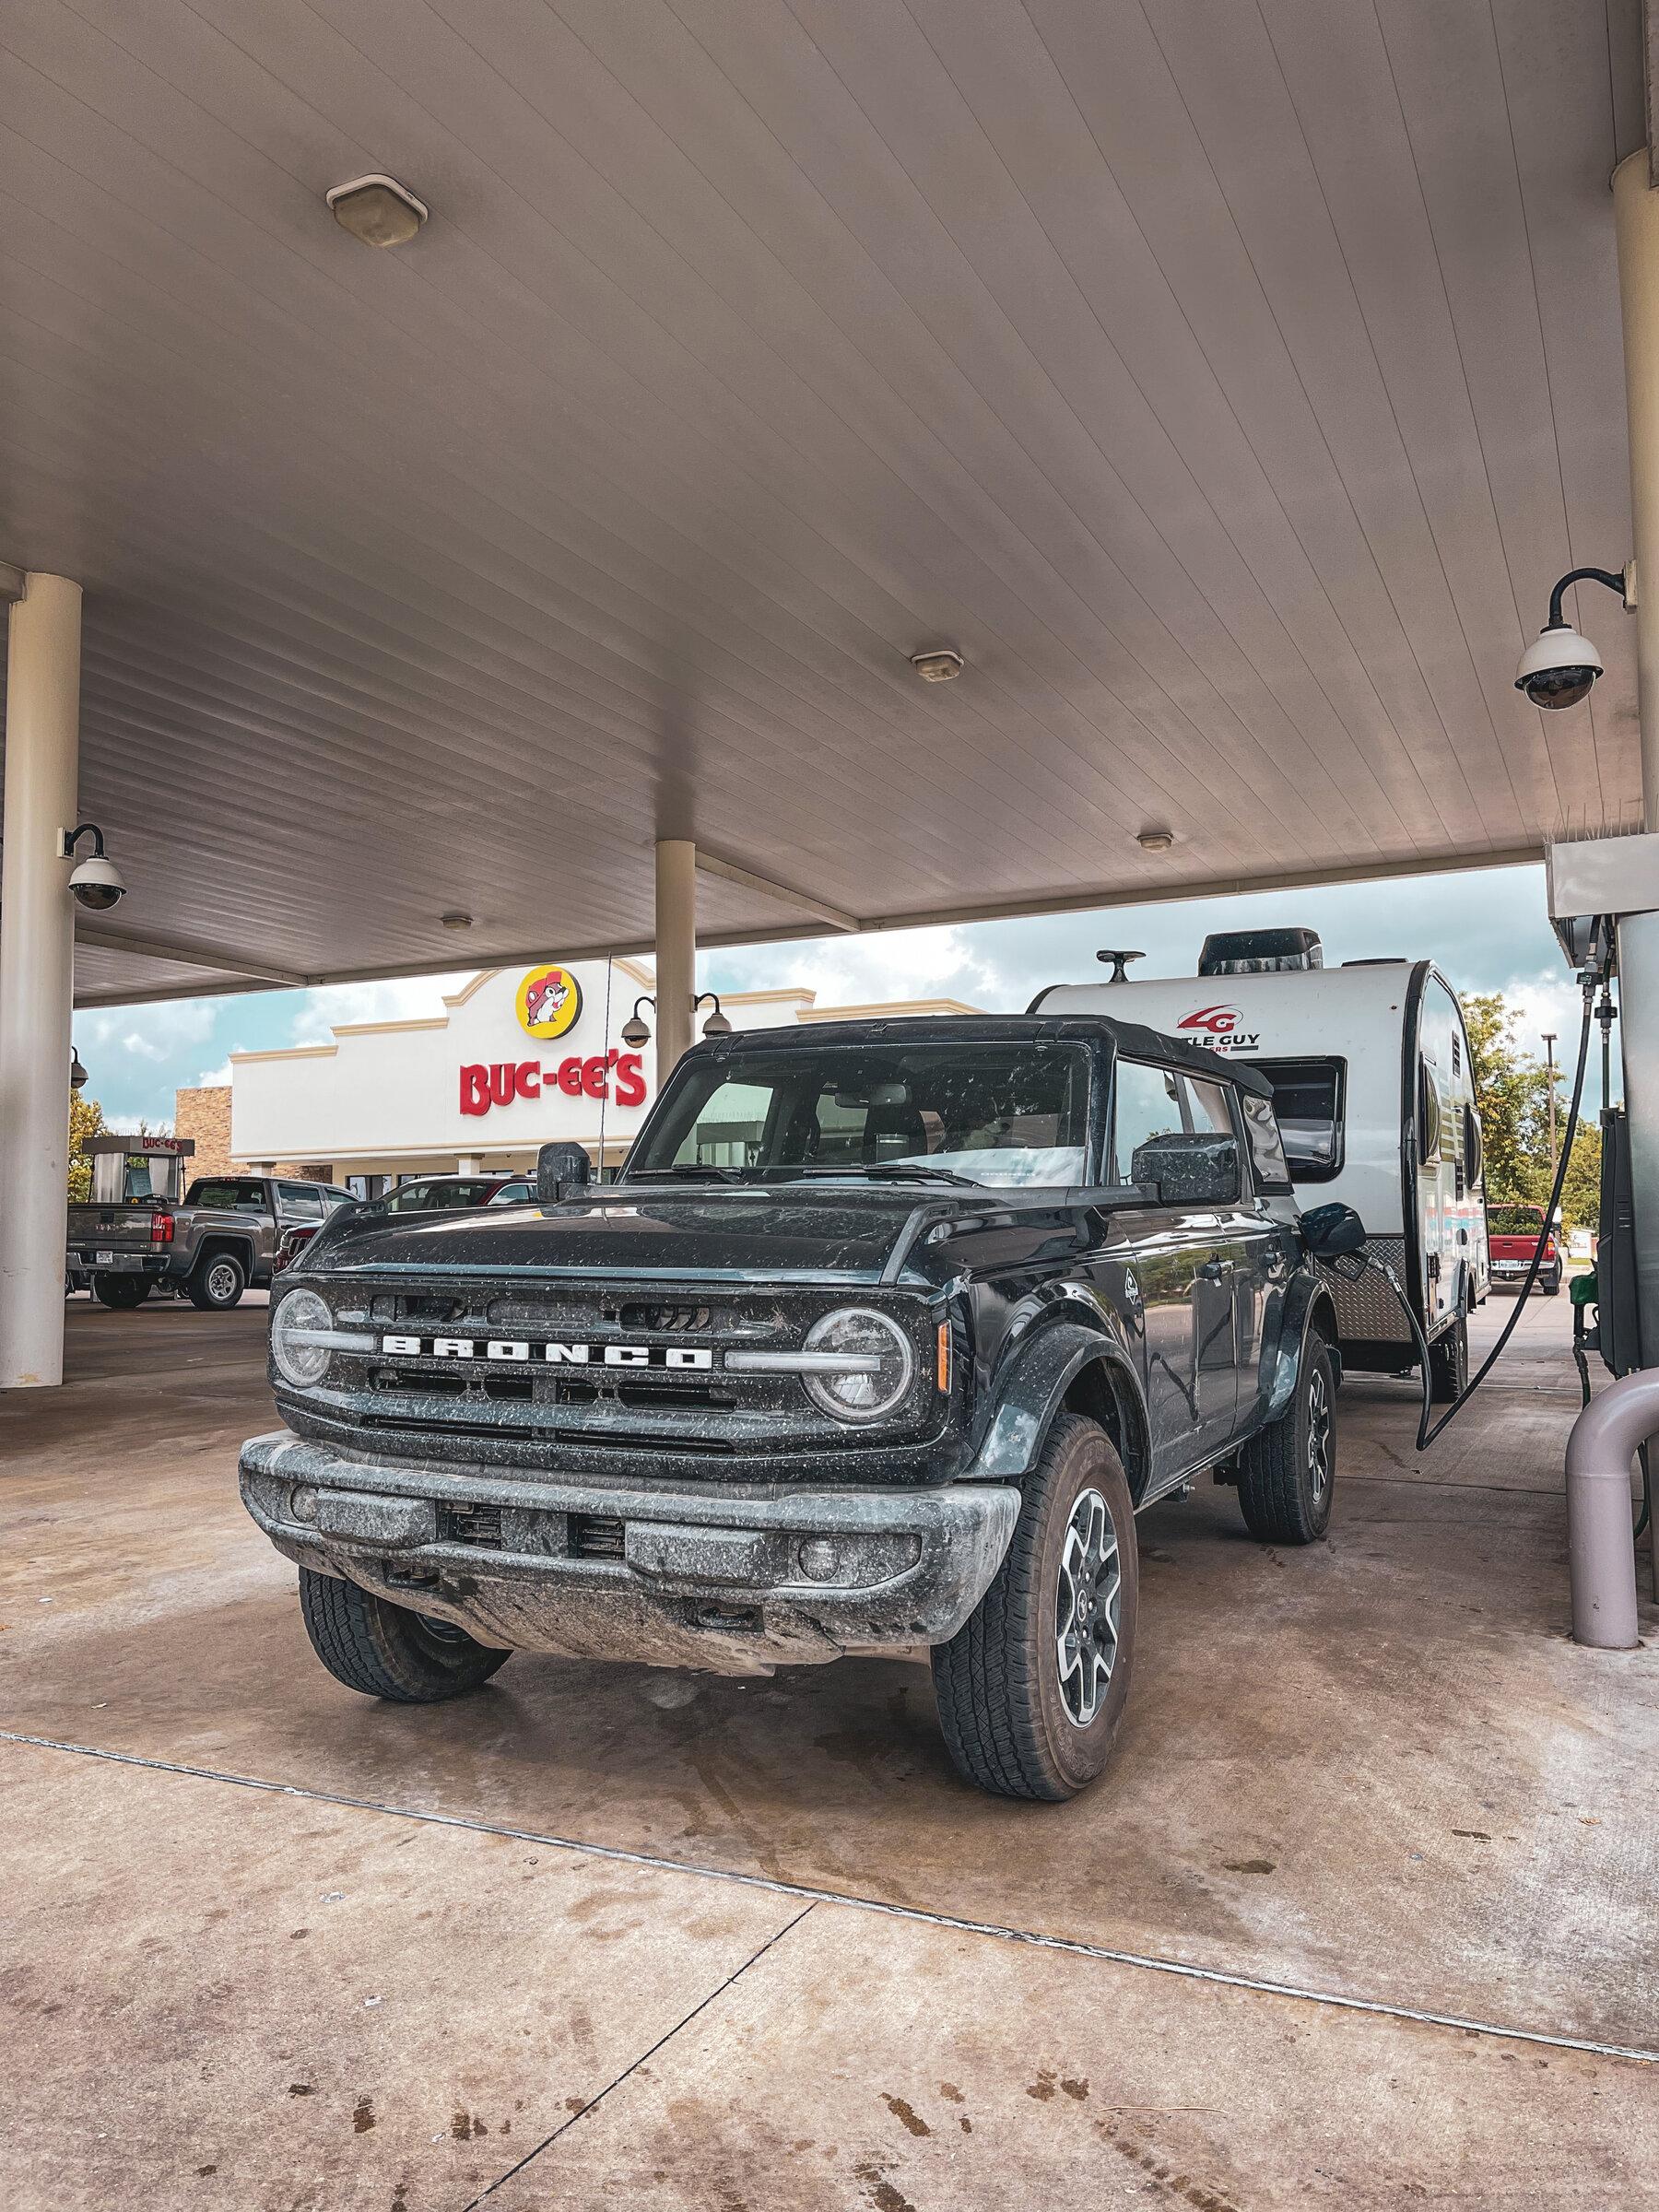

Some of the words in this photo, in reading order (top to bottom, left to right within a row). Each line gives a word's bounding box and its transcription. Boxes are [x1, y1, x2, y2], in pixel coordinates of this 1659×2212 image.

[1219, 1034, 1260, 1045] GUY
[460, 1048, 647, 1116] BUC-EE'S
[382, 1335, 712, 1369] BRONCO
